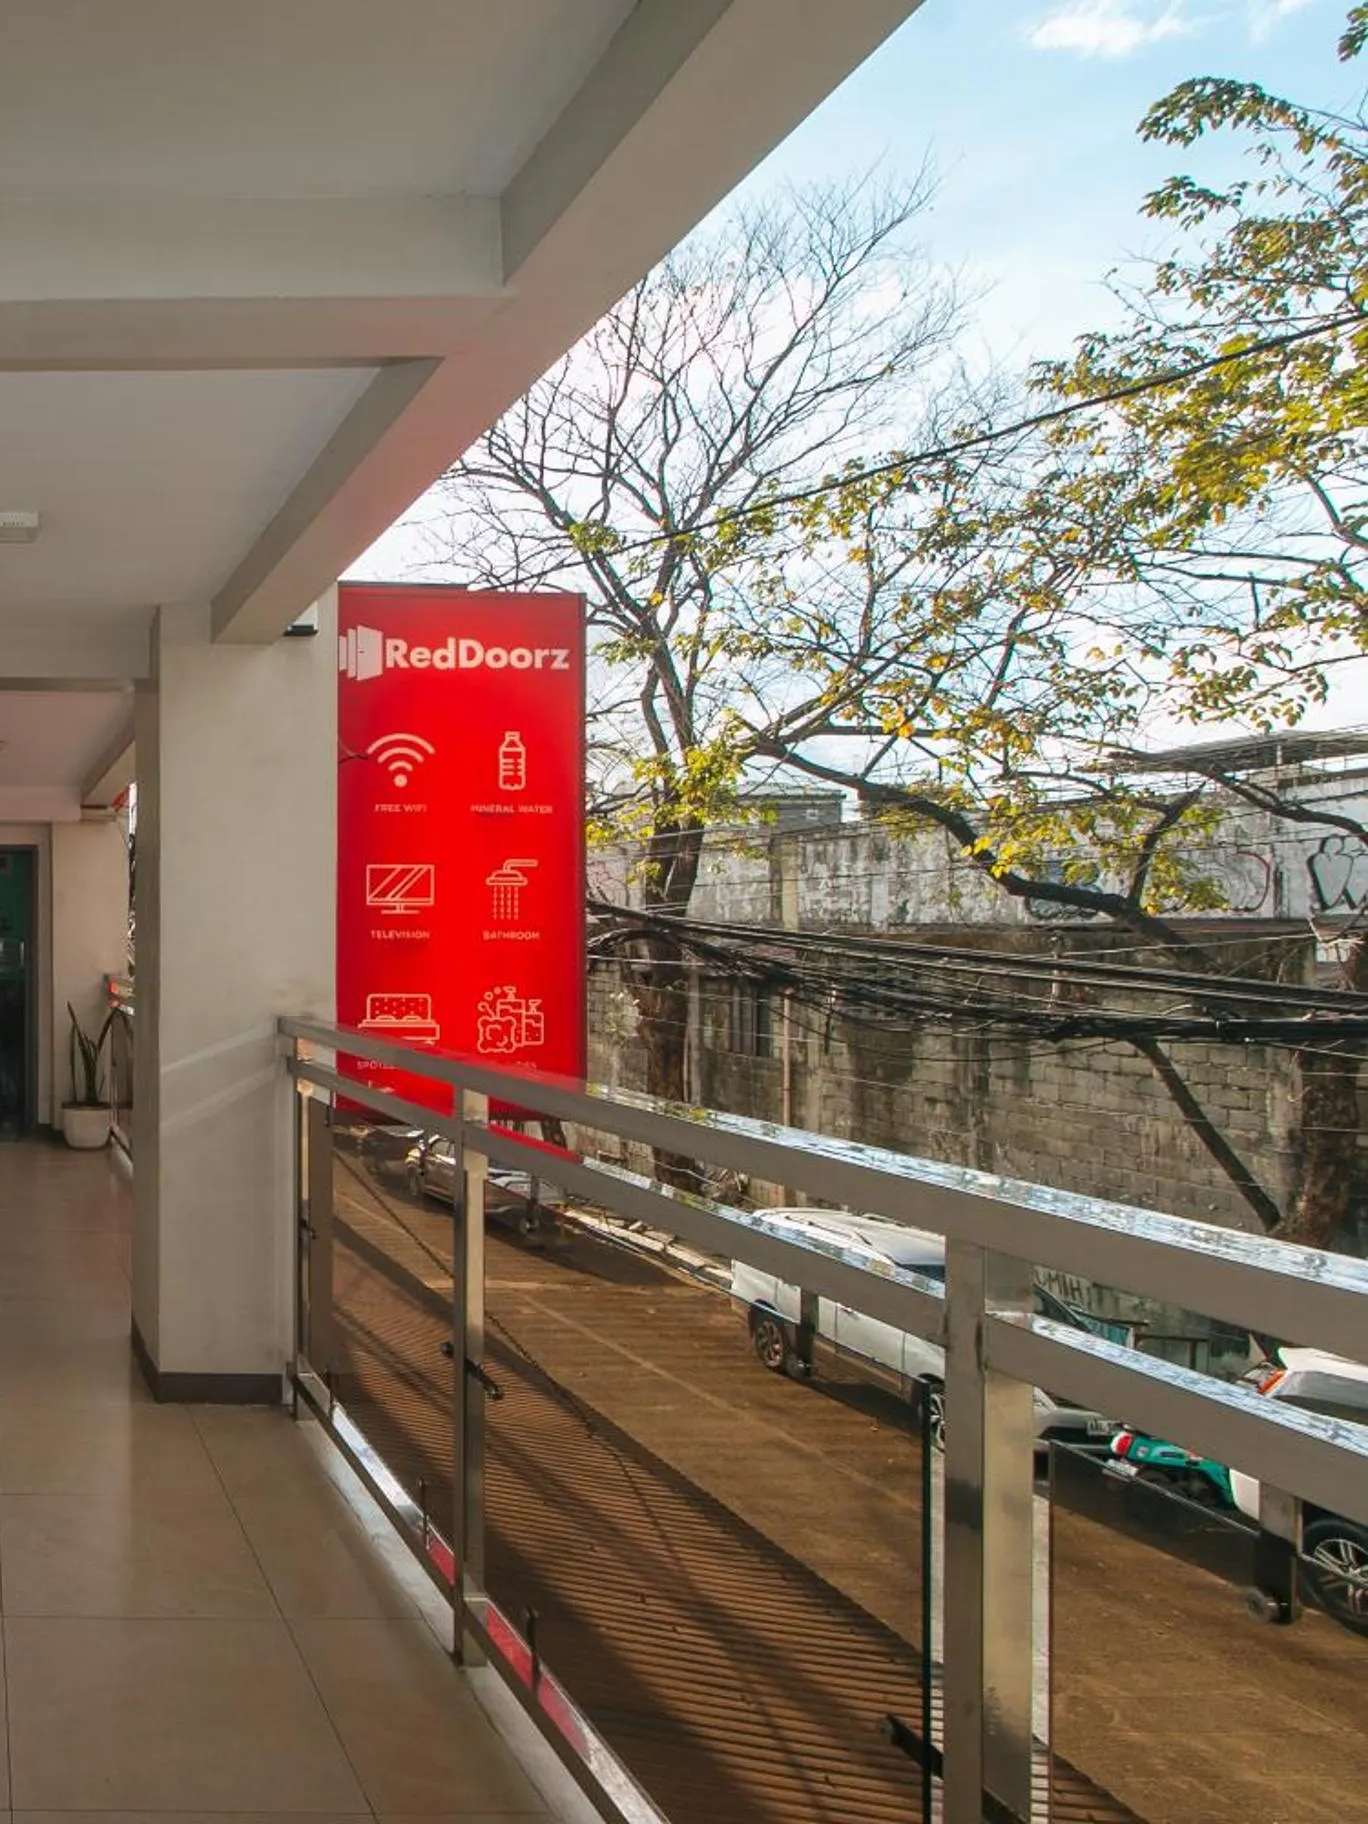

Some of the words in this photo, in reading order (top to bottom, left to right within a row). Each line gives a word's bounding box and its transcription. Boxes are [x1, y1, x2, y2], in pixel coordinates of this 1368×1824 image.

[385, 637, 570, 670] RedDoorz
[374, 803, 401, 813] FREE
[470, 803, 515, 814] MINERAL
[518, 804, 553, 814] WATER
[370, 929, 430, 940] TELEVISION
[482, 930, 540, 941] BATHROOM
